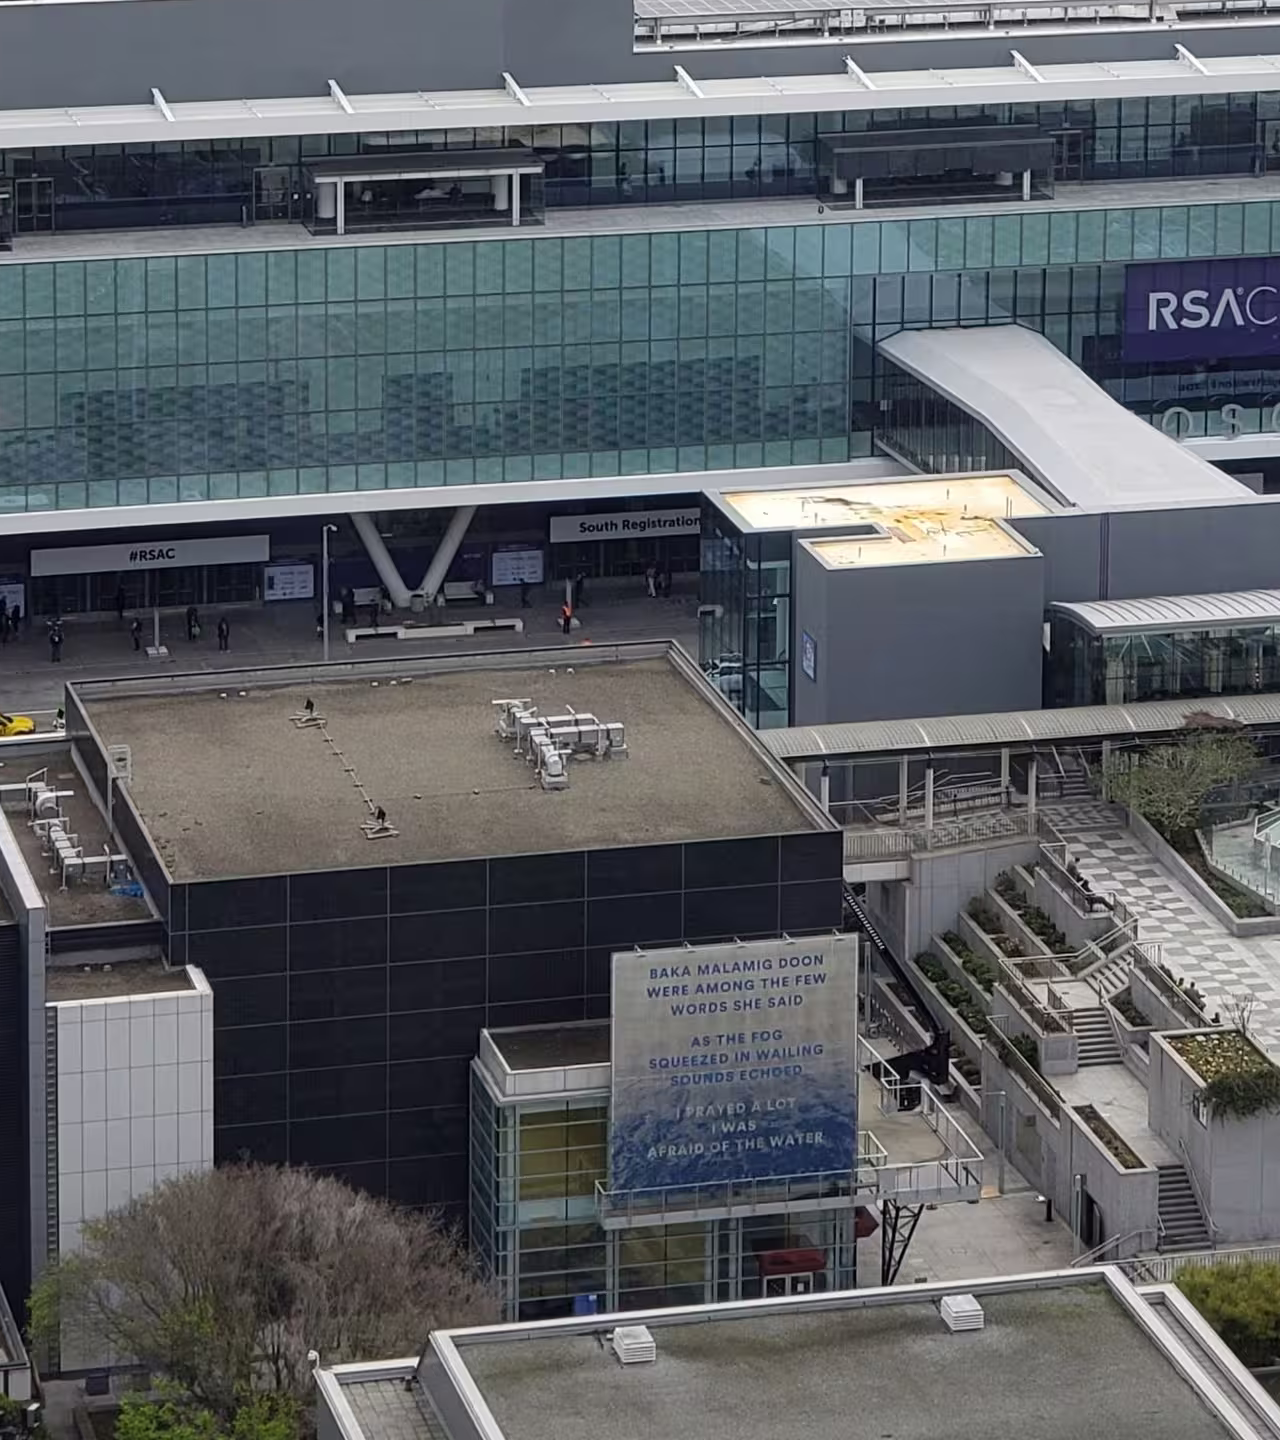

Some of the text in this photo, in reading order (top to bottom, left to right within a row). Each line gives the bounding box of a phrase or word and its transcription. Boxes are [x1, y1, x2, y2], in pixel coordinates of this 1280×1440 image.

[579, 515, 701, 534] South Registration
[129, 547, 176, 563] #RSAC
[649, 954, 824, 980] BAKA MALAMIG DOON
[646, 973, 827, 999] WERE AMONG THE FEW
[671, 994, 804, 1017] WORDS SHE SAID
[691, 1029, 784, 1048] AS THE FOG
[649, 1044, 824, 1070] SQUEEZED IN WAILING
[670, 1065, 803, 1087] SOUNDS ECHOED
[686, 1102, 747, 1119] PRAYED
[751, 1101, 761, 1112] A
[767, 1097, 797, 1111] LOT
[721, 1119, 757, 1132] WAS
[647, 1131, 824, 1160] AFRAID OF THE WATER
